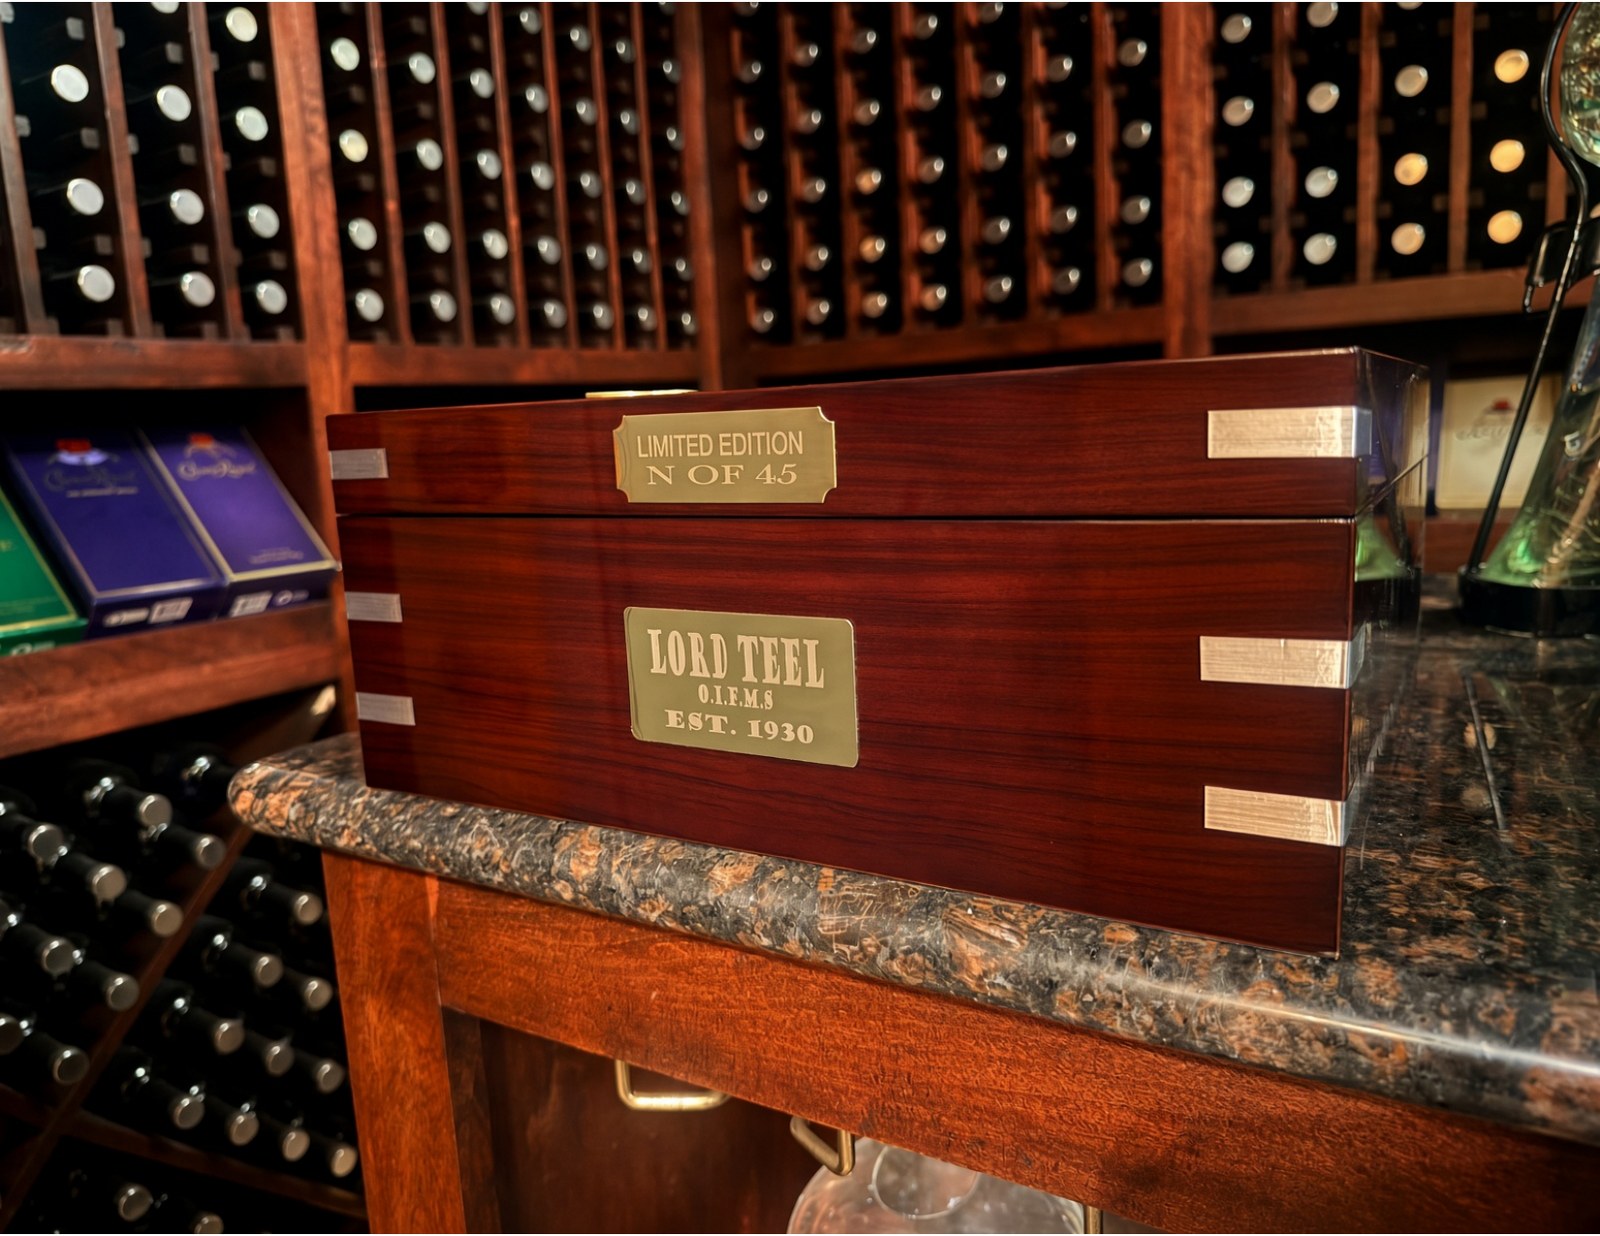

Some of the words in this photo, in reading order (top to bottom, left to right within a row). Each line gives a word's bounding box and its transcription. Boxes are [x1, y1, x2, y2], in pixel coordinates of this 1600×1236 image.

[636, 433, 714, 458] LIMITED
[719, 430, 803, 456] EDITION
[647, 465, 674, 485] N
[688, 464, 744, 485] OF
[755, 464, 798, 485] 45
[647, 628, 729, 680] LORD
[737, 634, 825, 689] TEEL
[698, 683, 774, 710] O.I.F.M.S
[664, 709, 737, 735] EST.
[747, 719, 815, 745] 1930
